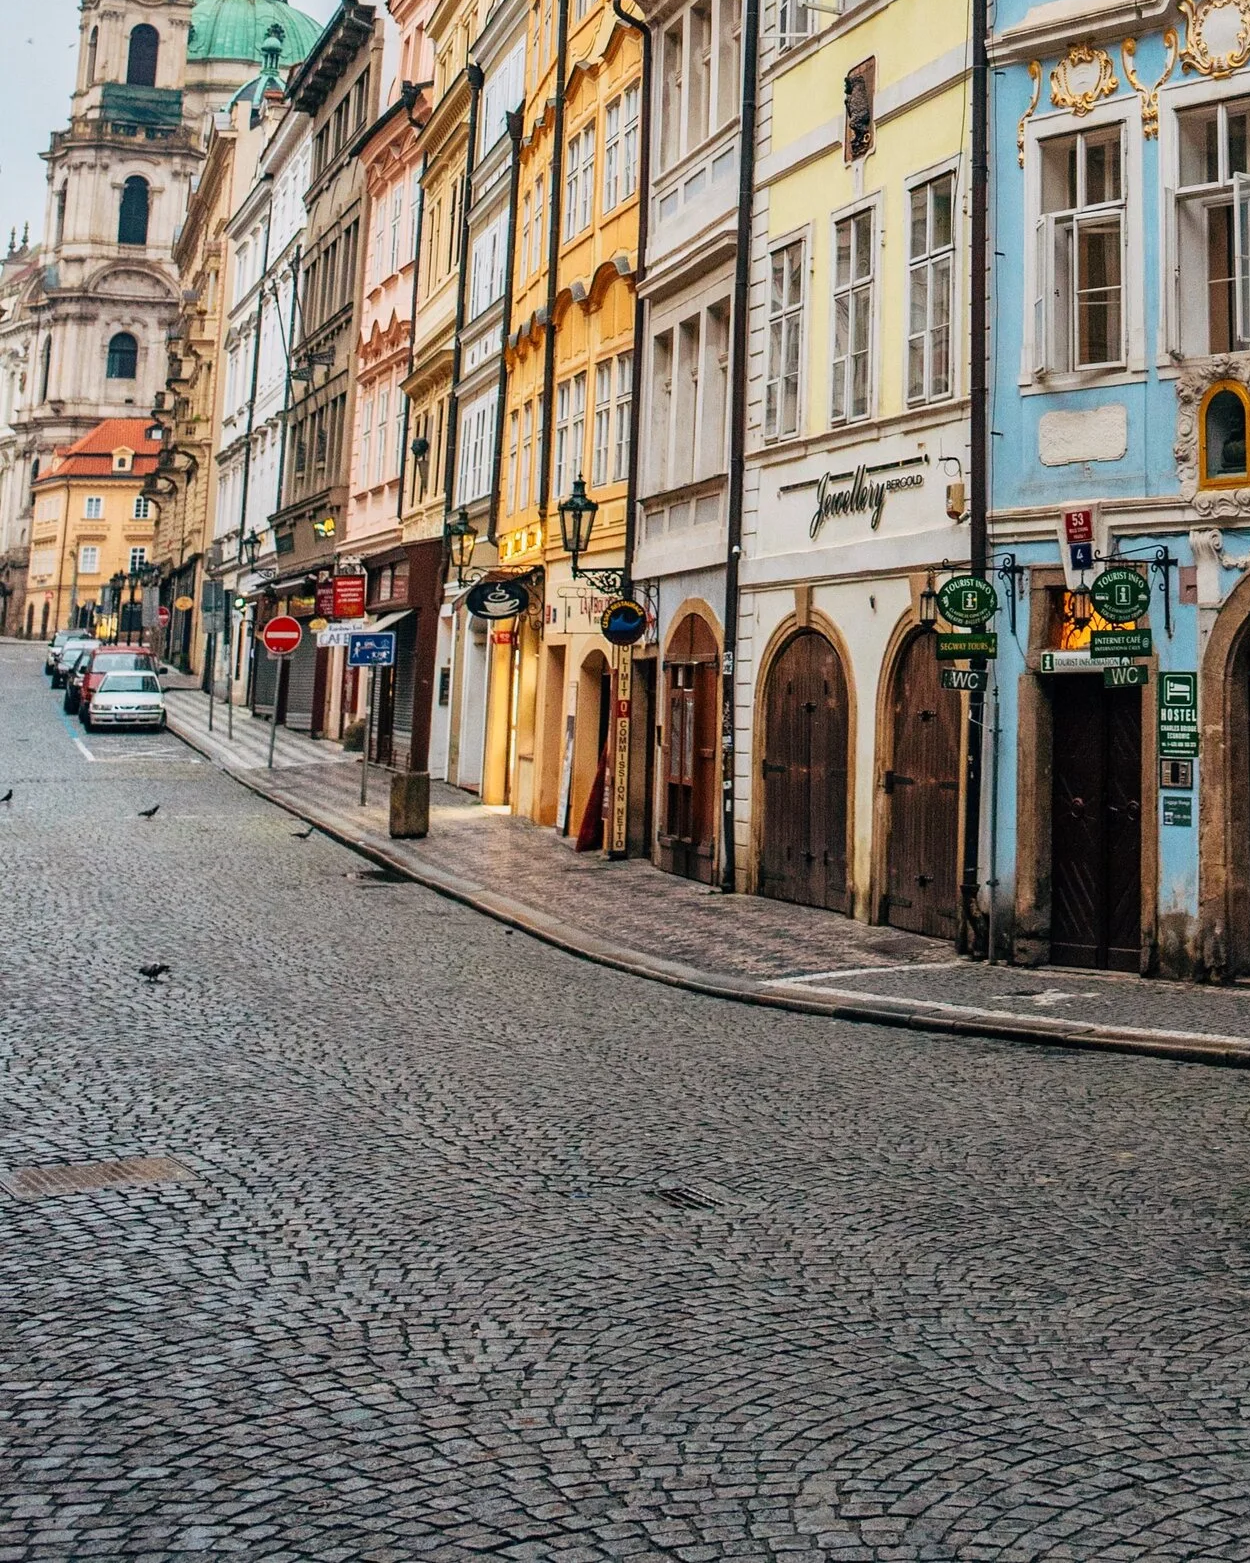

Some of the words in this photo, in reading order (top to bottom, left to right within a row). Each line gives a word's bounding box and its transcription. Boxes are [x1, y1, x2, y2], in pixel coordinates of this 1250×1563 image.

[810, 464, 885, 539] Jewellery
[1072, 513, 1084, 526] 53
[944, 578, 974, 595] TOURIST
[975, 579, 991, 594] INFO
[1097, 571, 1127, 588] TOURIST
[1128, 572, 1144, 588] INFO
[940, 642, 966, 651] SEGWAY
[968, 642, 988, 651] TOURS
[1094, 637, 1125, 645] INTERNET
[1125, 634, 1141, 644] CAFÉ
[1055, 658, 1078, 667] TOURIST
[1079, 657, 1119, 667] INFORMATION
[621, 657, 629, 696] LIMIT
[952, 671, 979, 689] WC
[1112, 667, 1139, 685] WC
[1161, 708, 1197, 722] HOSTEL
[616, 720, 627, 802] COMMISSION
[615, 807, 625, 848] NETTO
